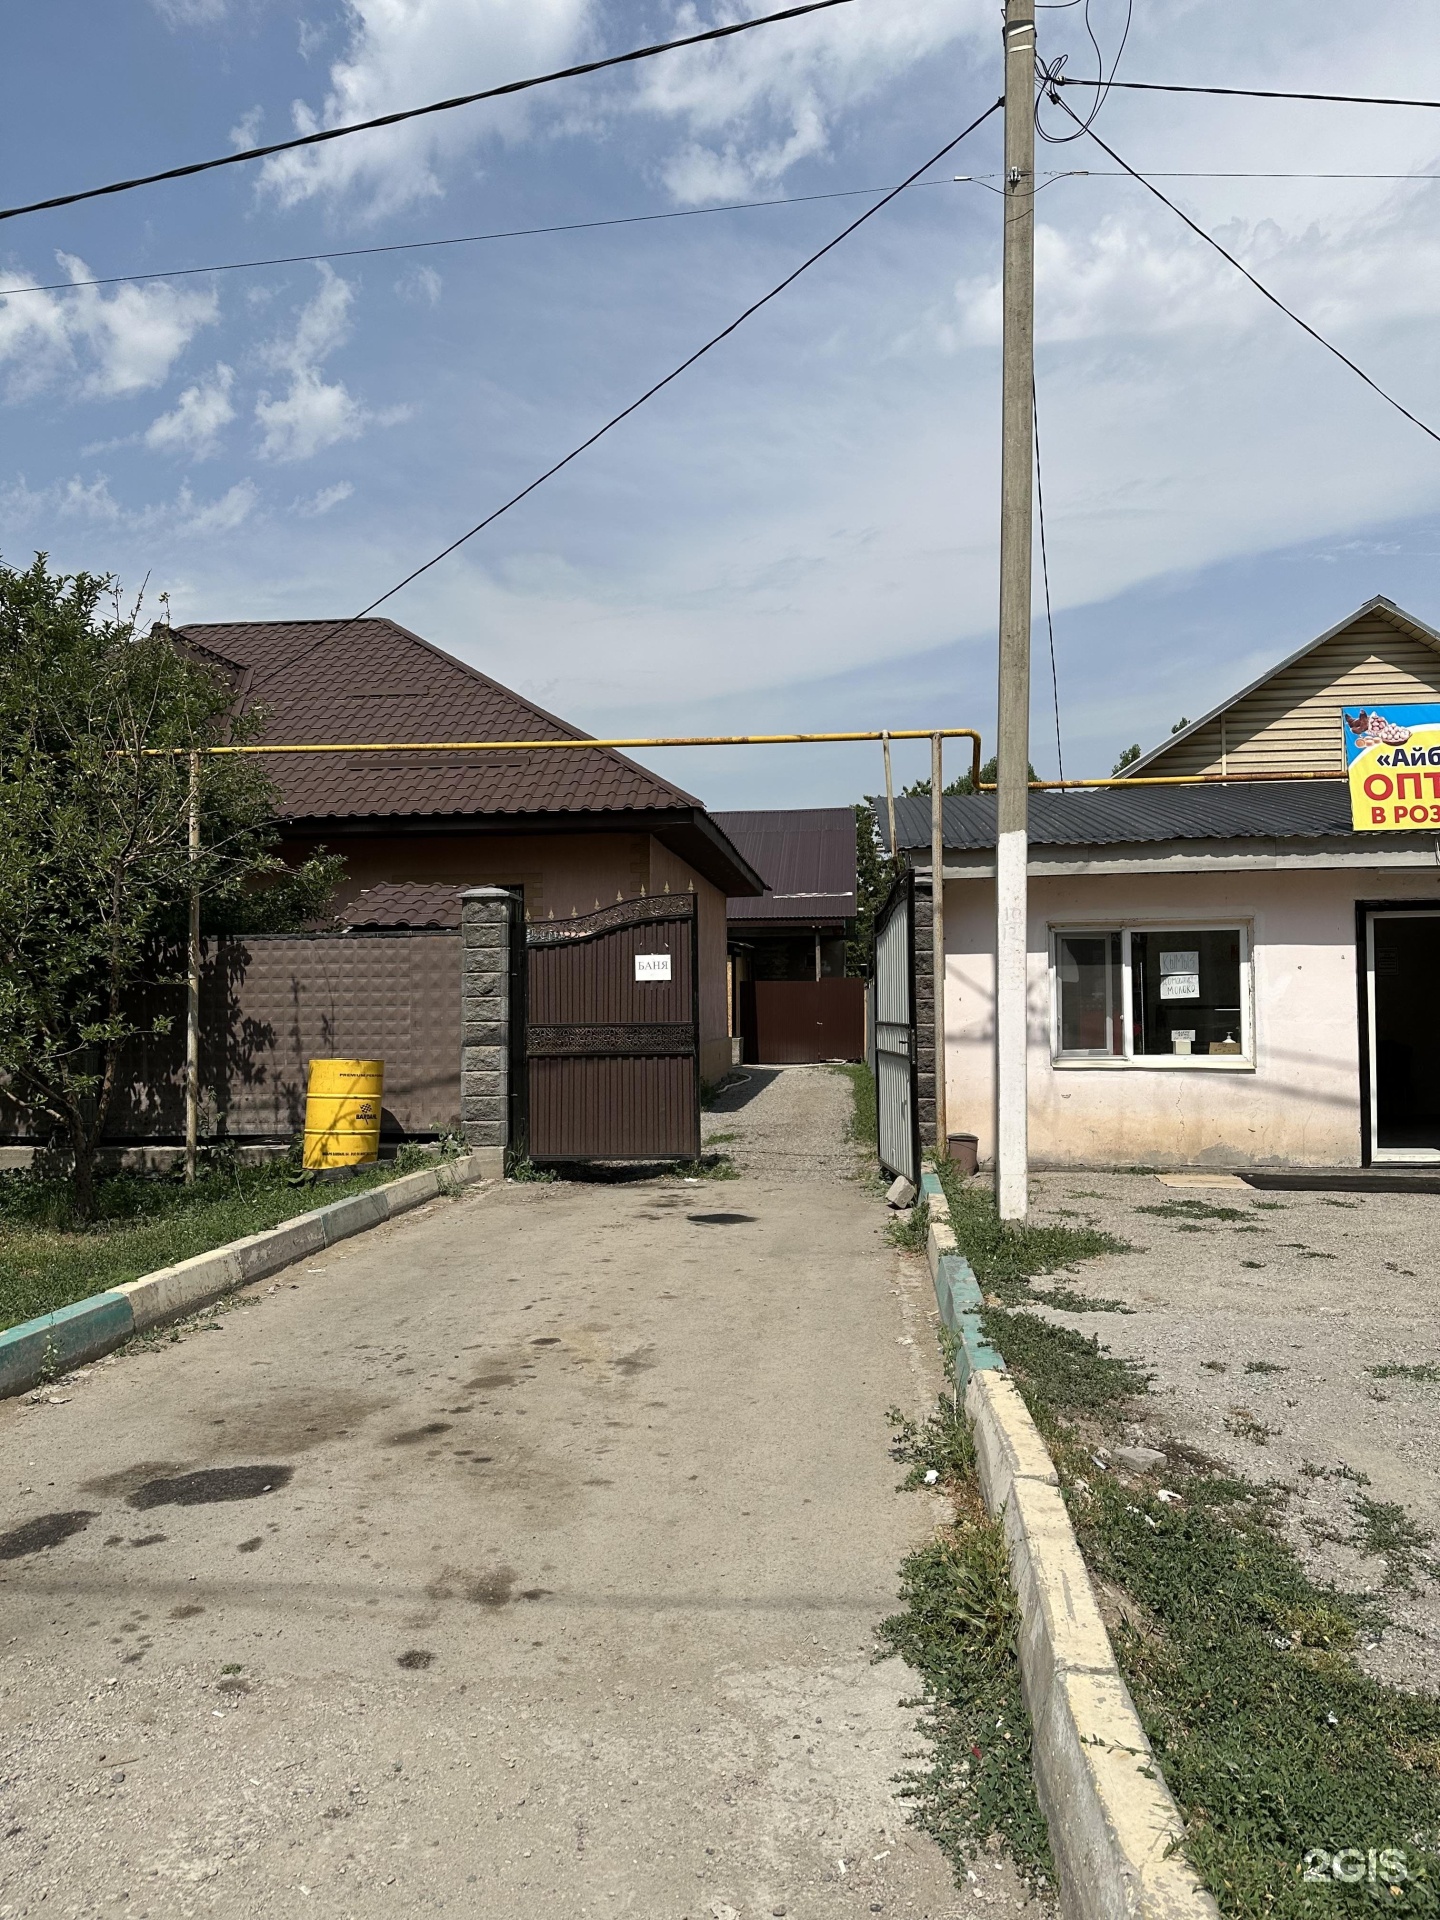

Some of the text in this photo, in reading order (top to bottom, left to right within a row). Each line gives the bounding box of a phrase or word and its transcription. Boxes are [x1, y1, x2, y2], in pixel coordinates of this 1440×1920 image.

[1363, 772, 1440, 801] ОПТ
[1371, 804, 1440, 824] В РОЗ
[638, 960, 669, 970] БАНЯ
